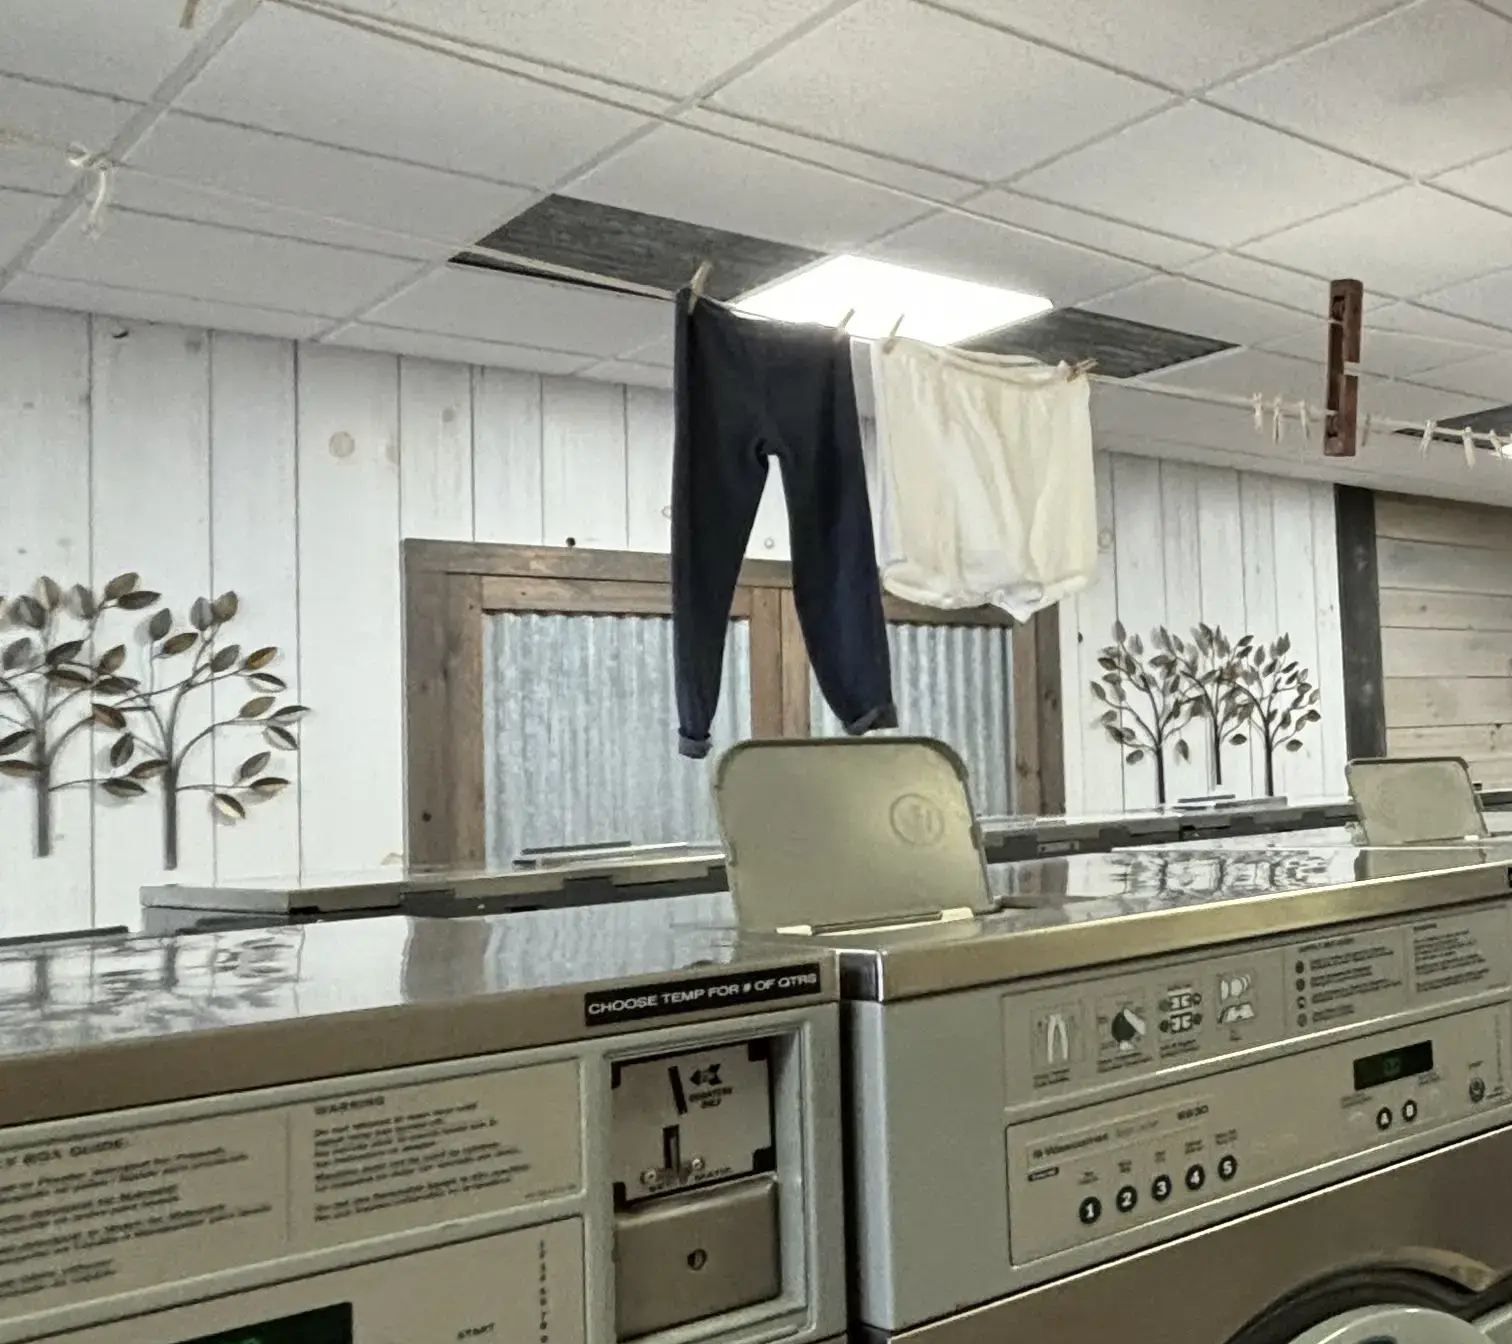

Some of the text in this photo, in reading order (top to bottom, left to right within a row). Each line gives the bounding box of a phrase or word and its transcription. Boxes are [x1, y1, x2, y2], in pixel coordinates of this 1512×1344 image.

[588, 972, 818, 1015] CHOOSE TEMP FOR # OF QTRS
[1085, 1161, 1232, 1218] 1 2 3 4 5
